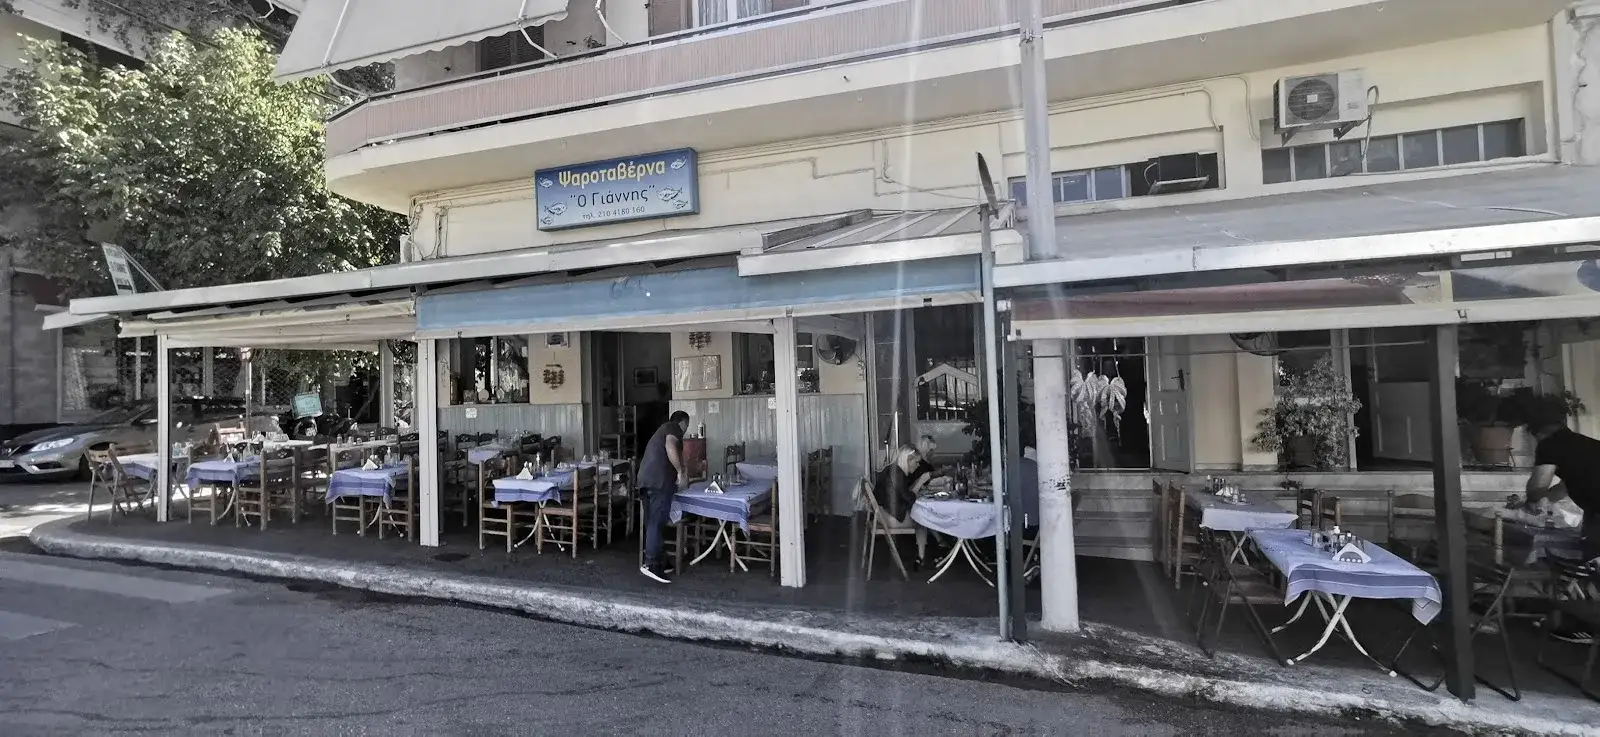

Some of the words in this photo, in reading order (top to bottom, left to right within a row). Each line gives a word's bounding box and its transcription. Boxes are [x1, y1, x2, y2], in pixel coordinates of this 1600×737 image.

[558, 160, 666, 189] Ψαροταβέρνα
[598, 210, 611, 218] 210
[632, 205, 645, 213] 160
